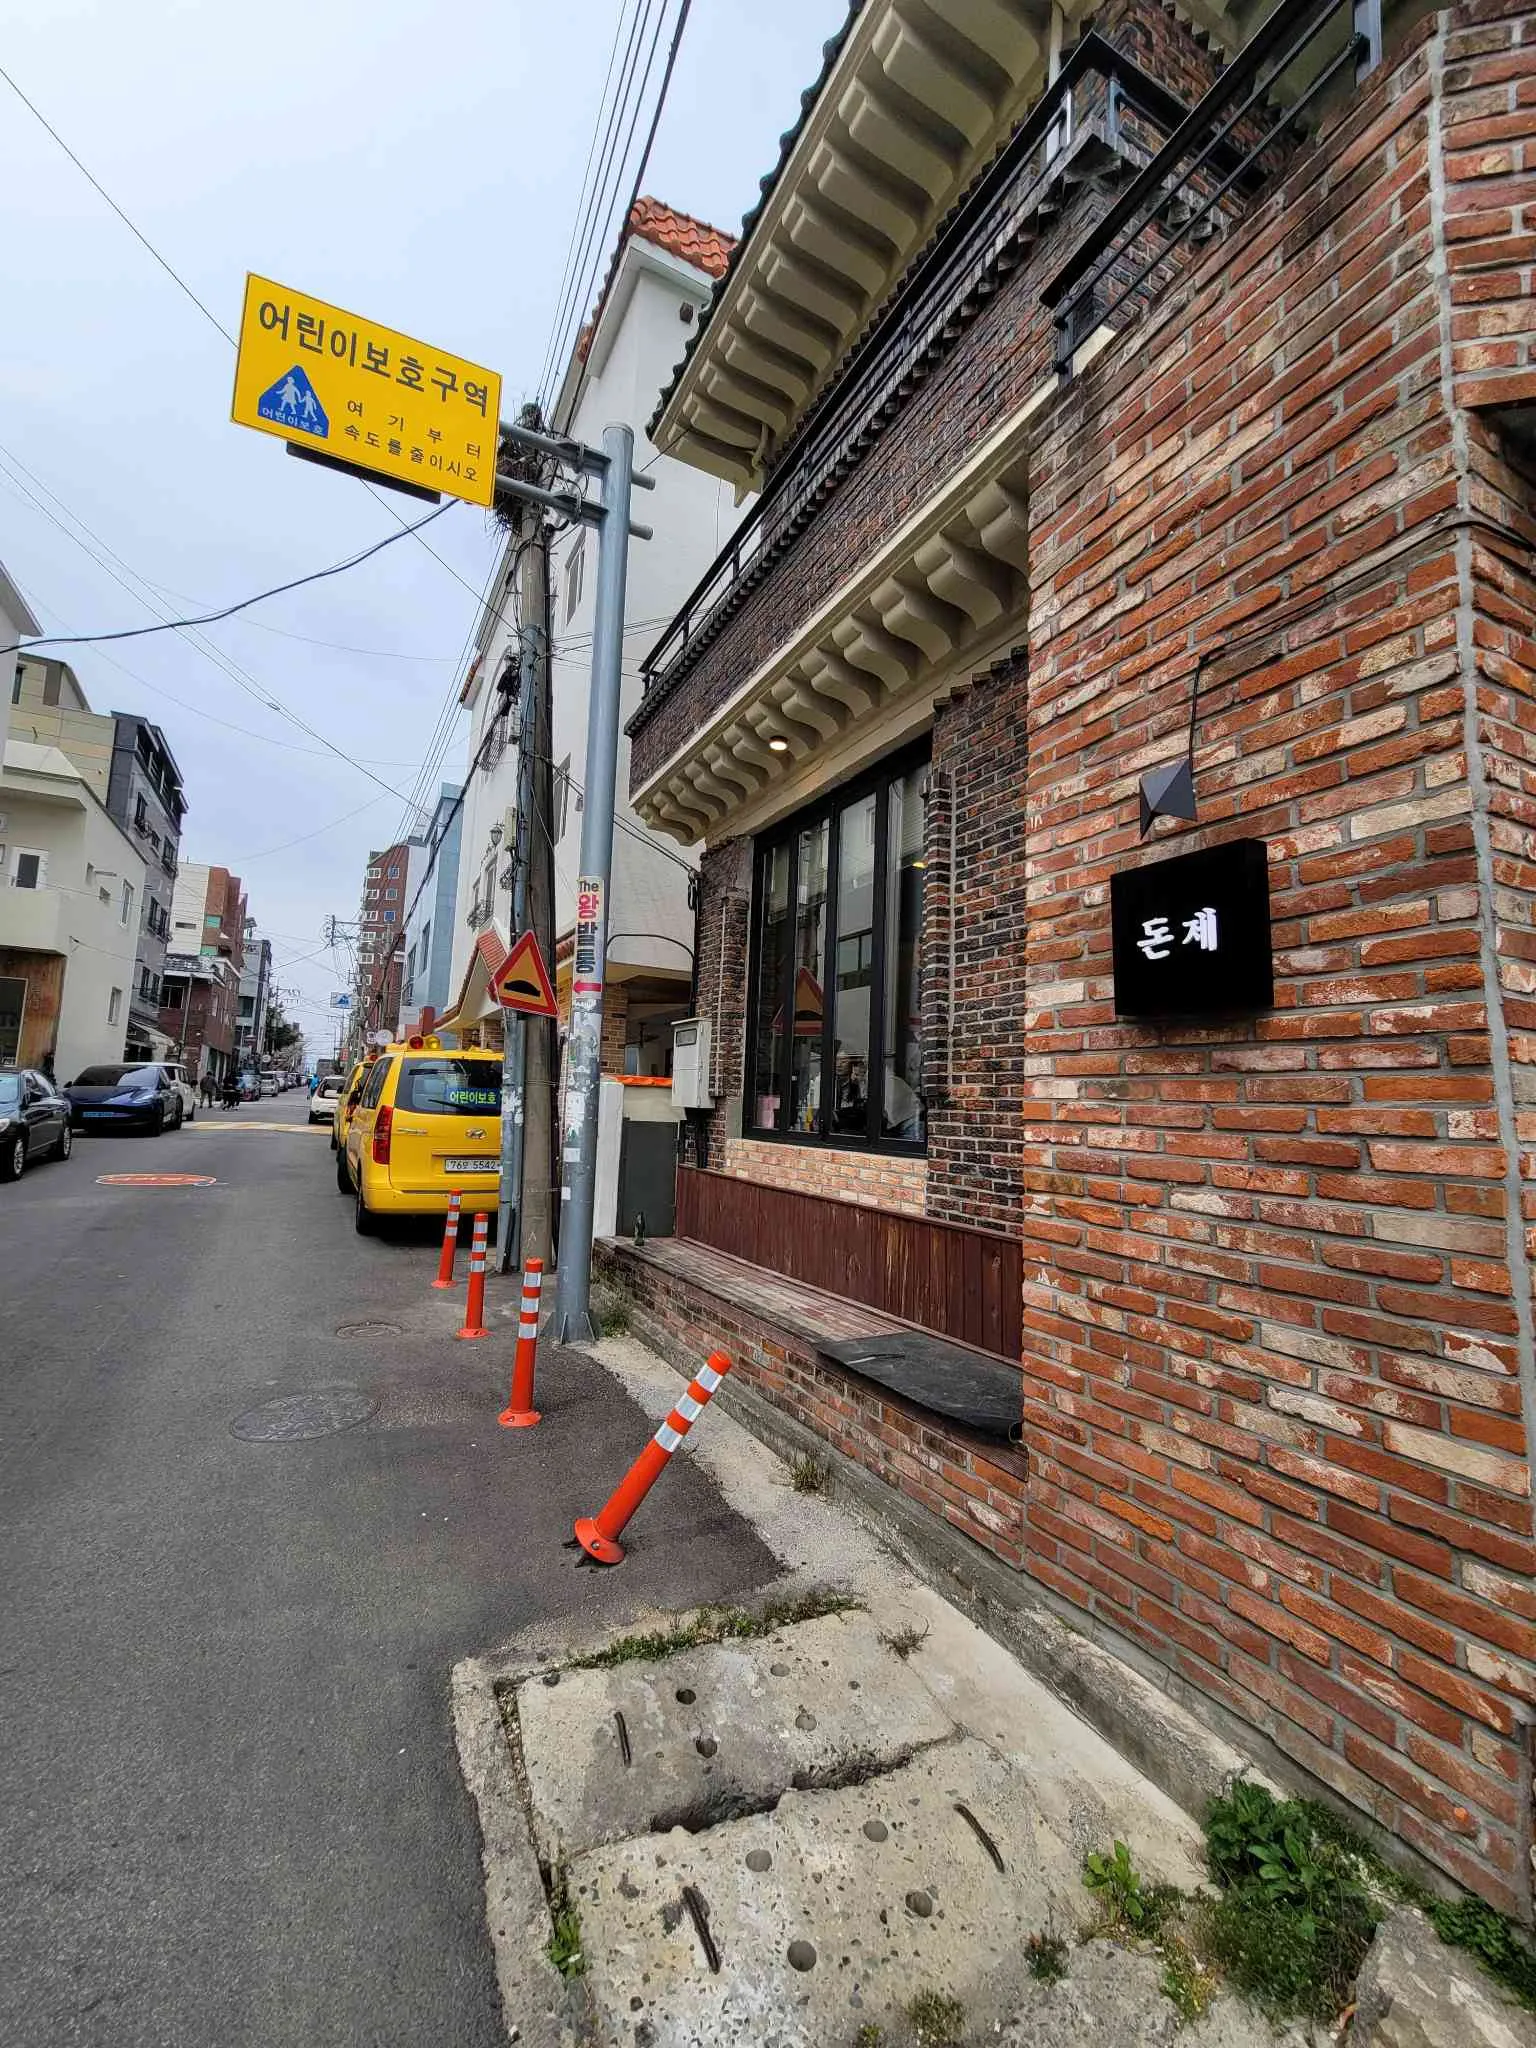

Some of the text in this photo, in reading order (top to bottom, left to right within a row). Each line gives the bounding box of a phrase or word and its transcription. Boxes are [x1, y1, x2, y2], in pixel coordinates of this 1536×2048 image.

[258, 301, 488, 417] 어린이보호구역
[262, 407, 324, 435] 어린이보호
[578, 880, 599, 893] The
[449, 1091, 497, 1104] 어린이보호
